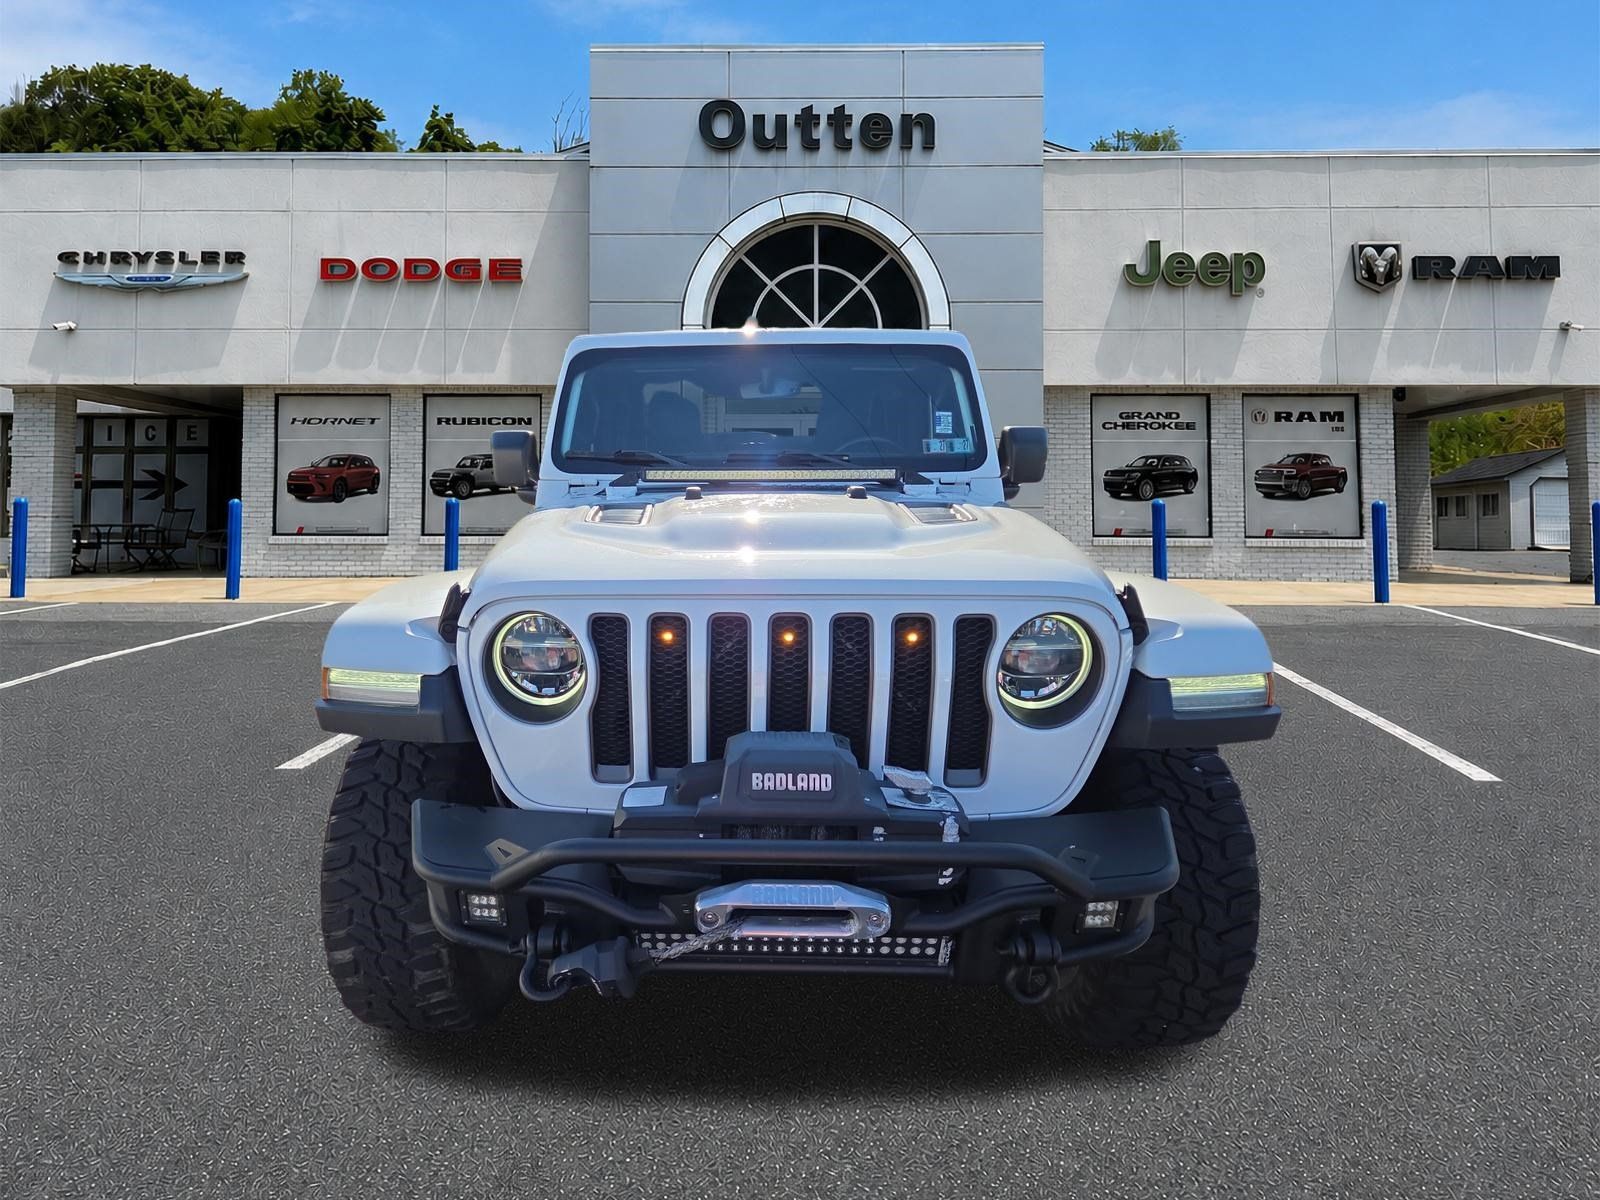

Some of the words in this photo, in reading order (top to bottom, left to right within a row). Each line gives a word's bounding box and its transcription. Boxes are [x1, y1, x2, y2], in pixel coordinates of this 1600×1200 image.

[698, 99, 936, 150] Outten
[57, 251, 247, 266] CHRYSLER
[320, 257, 523, 282] DODGE
[1123, 240, 1266, 296] Jeep
[1411, 255, 1561, 281] RAM
[290, 417, 382, 426] HORNET
[436, 416, 533, 426] RUBICON
[1118, 411, 1181, 420] GRAND
[1274, 411, 1344, 422] RAM
[1101, 421, 1197, 431] CHEROKEE
[751, 772, 832, 791] BADLAND
